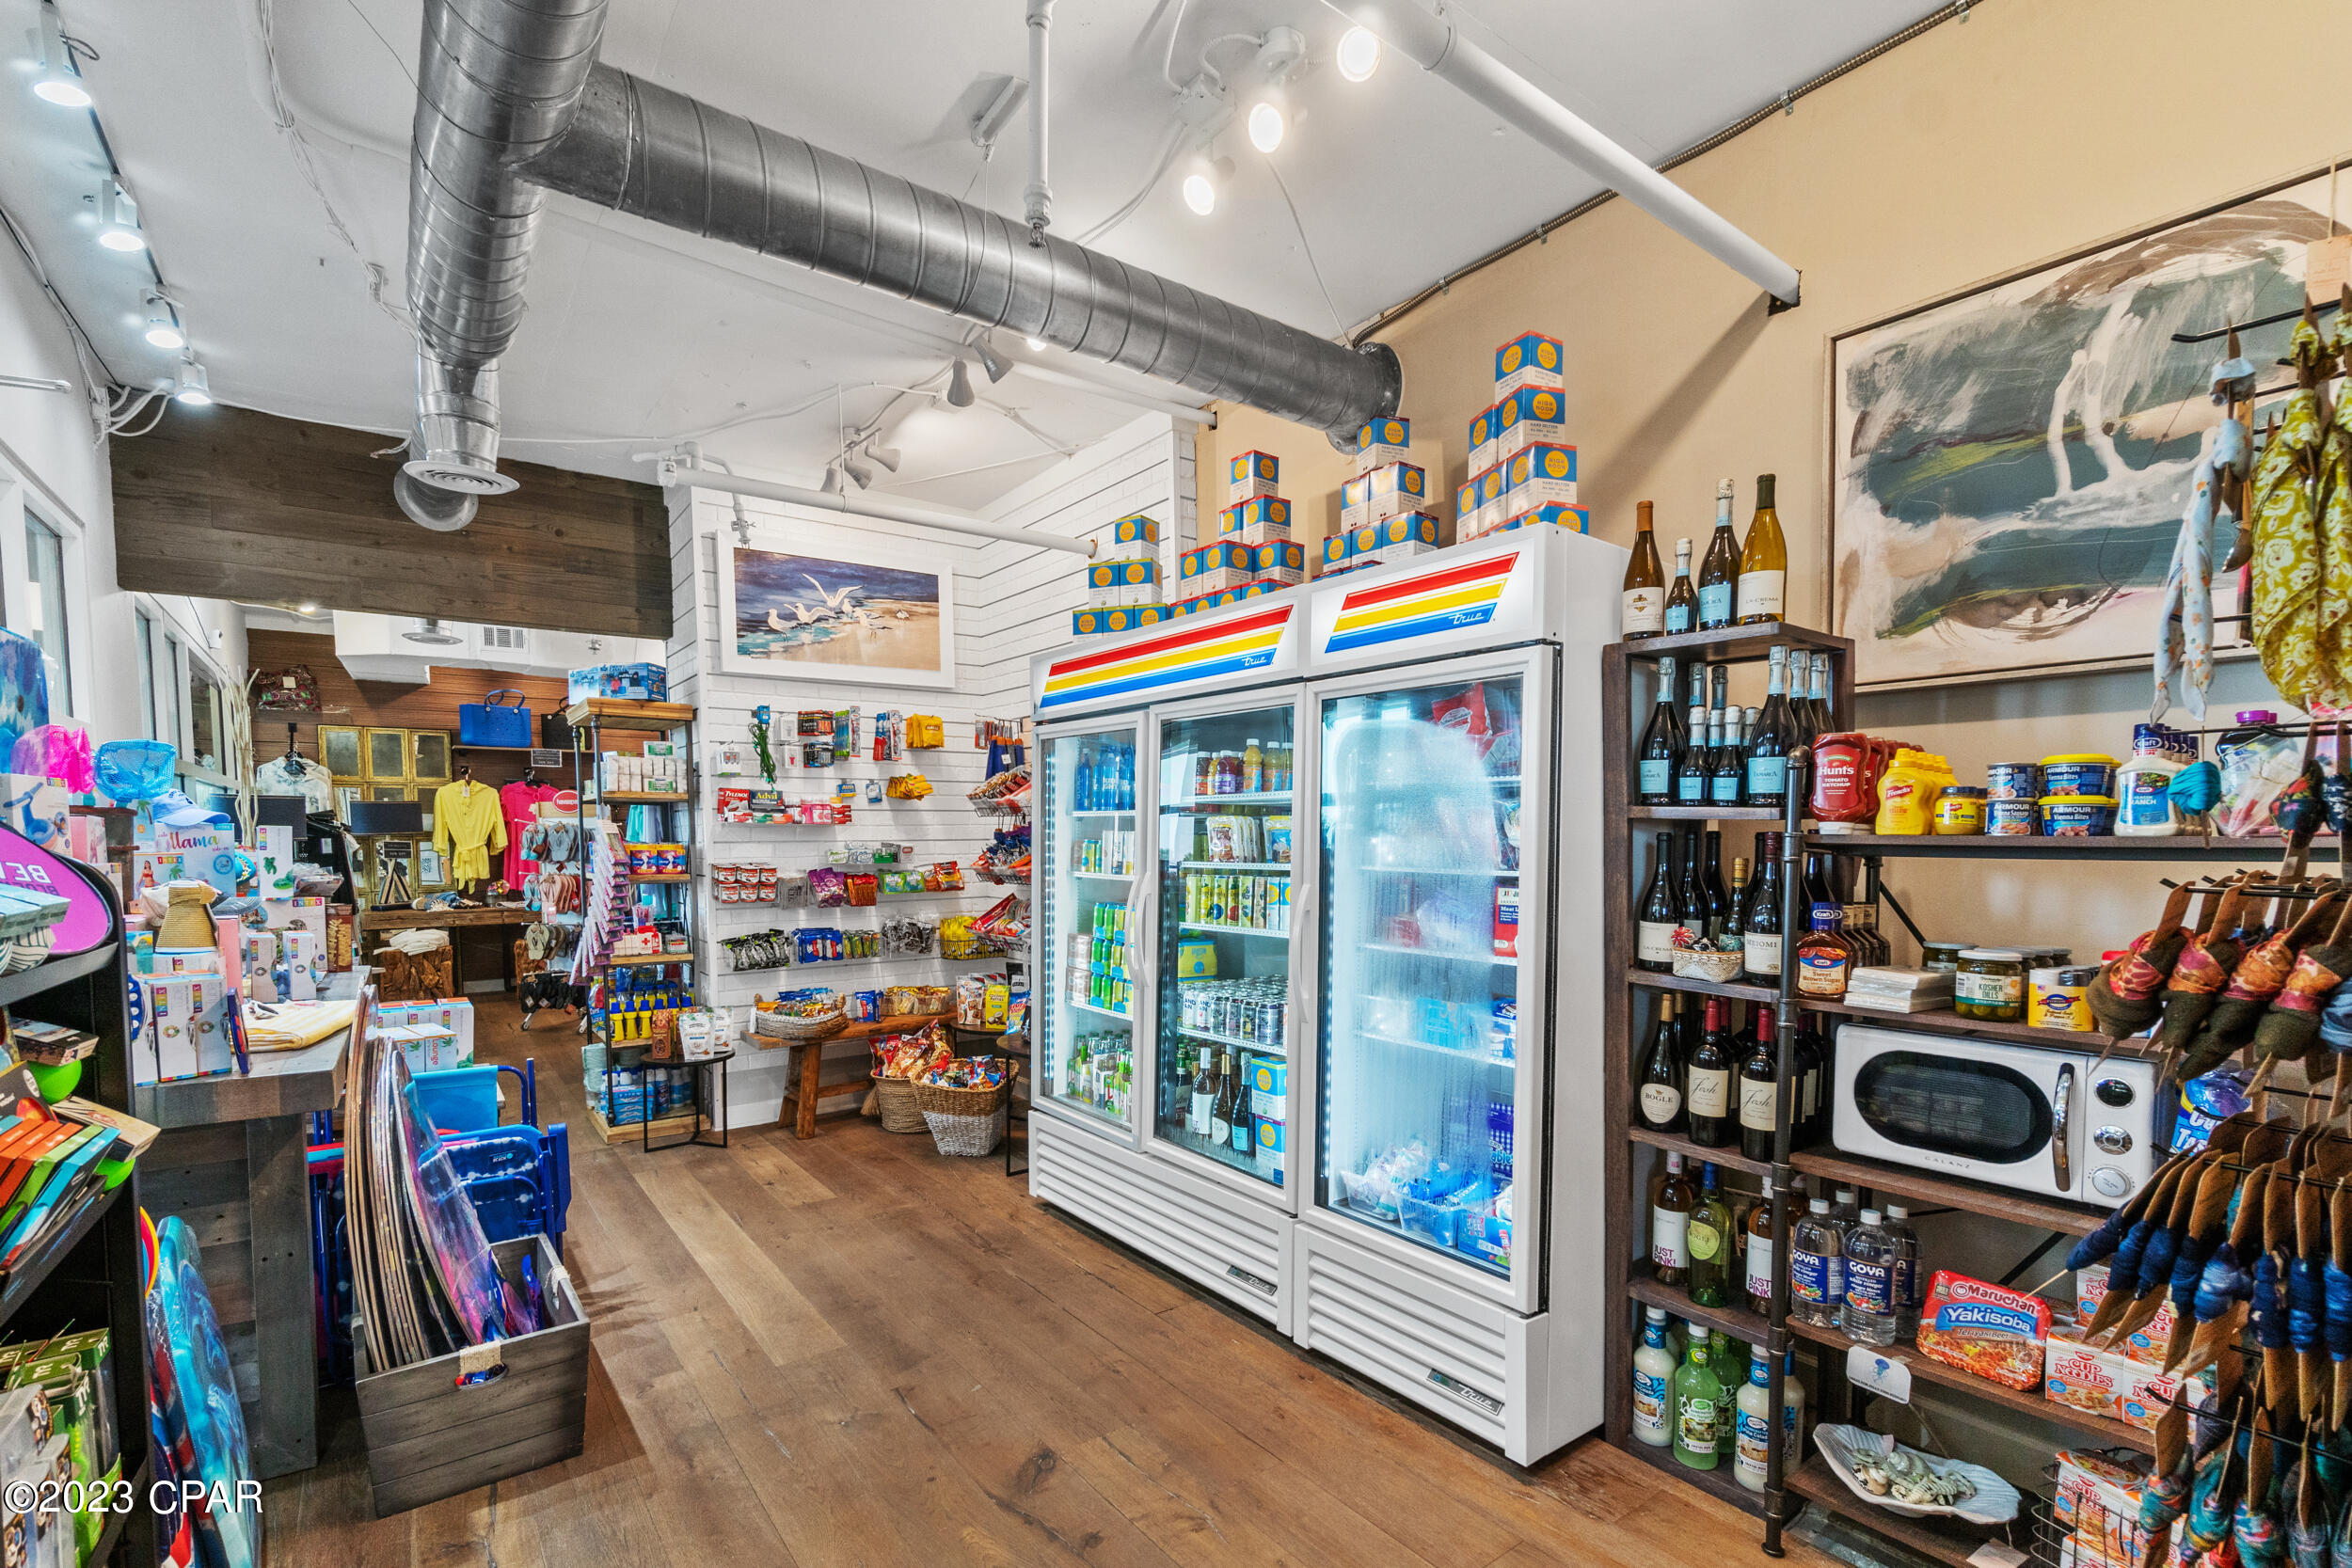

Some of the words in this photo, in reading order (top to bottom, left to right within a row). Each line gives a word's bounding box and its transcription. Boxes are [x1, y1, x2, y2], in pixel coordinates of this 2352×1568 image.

[1819, 765, 1854, 775] Hunt's
[169, 832, 218, 849] llama
[293, 898, 322, 907] INTEX
[1746, 939, 1777, 948] MEIOMI
[1979, 983, 2003, 991] KOSHER
[156, 988, 167, 1017] INTEX
[1691, 1077, 1720, 1097] Josh
[1645, 1093, 1674, 1103] BOGLE
[1741, 1089, 1773, 1109] Josh
[1924, 1155, 1971, 1169] GALANZ
[1655, 1244, 1674, 1258] JUST
[1793, 1249, 1820, 1265] GOYA
[1654, 1254, 1677, 1267] PINK!
[1850, 1261, 1885, 1277] GOYA
[1749, 1275, 1772, 1289] JUST
[1968, 1285, 2035, 1314] Maruchan
[1947, 1307, 2030, 1332] Yakisoba
[1958, 1328, 1991, 1337] Teriyaki
[2069, 1359, 2102, 1372] CUP
[2056, 1364, 2113, 1387] NOODLES
[2063, 1377, 2091, 1389] CHICKEN
